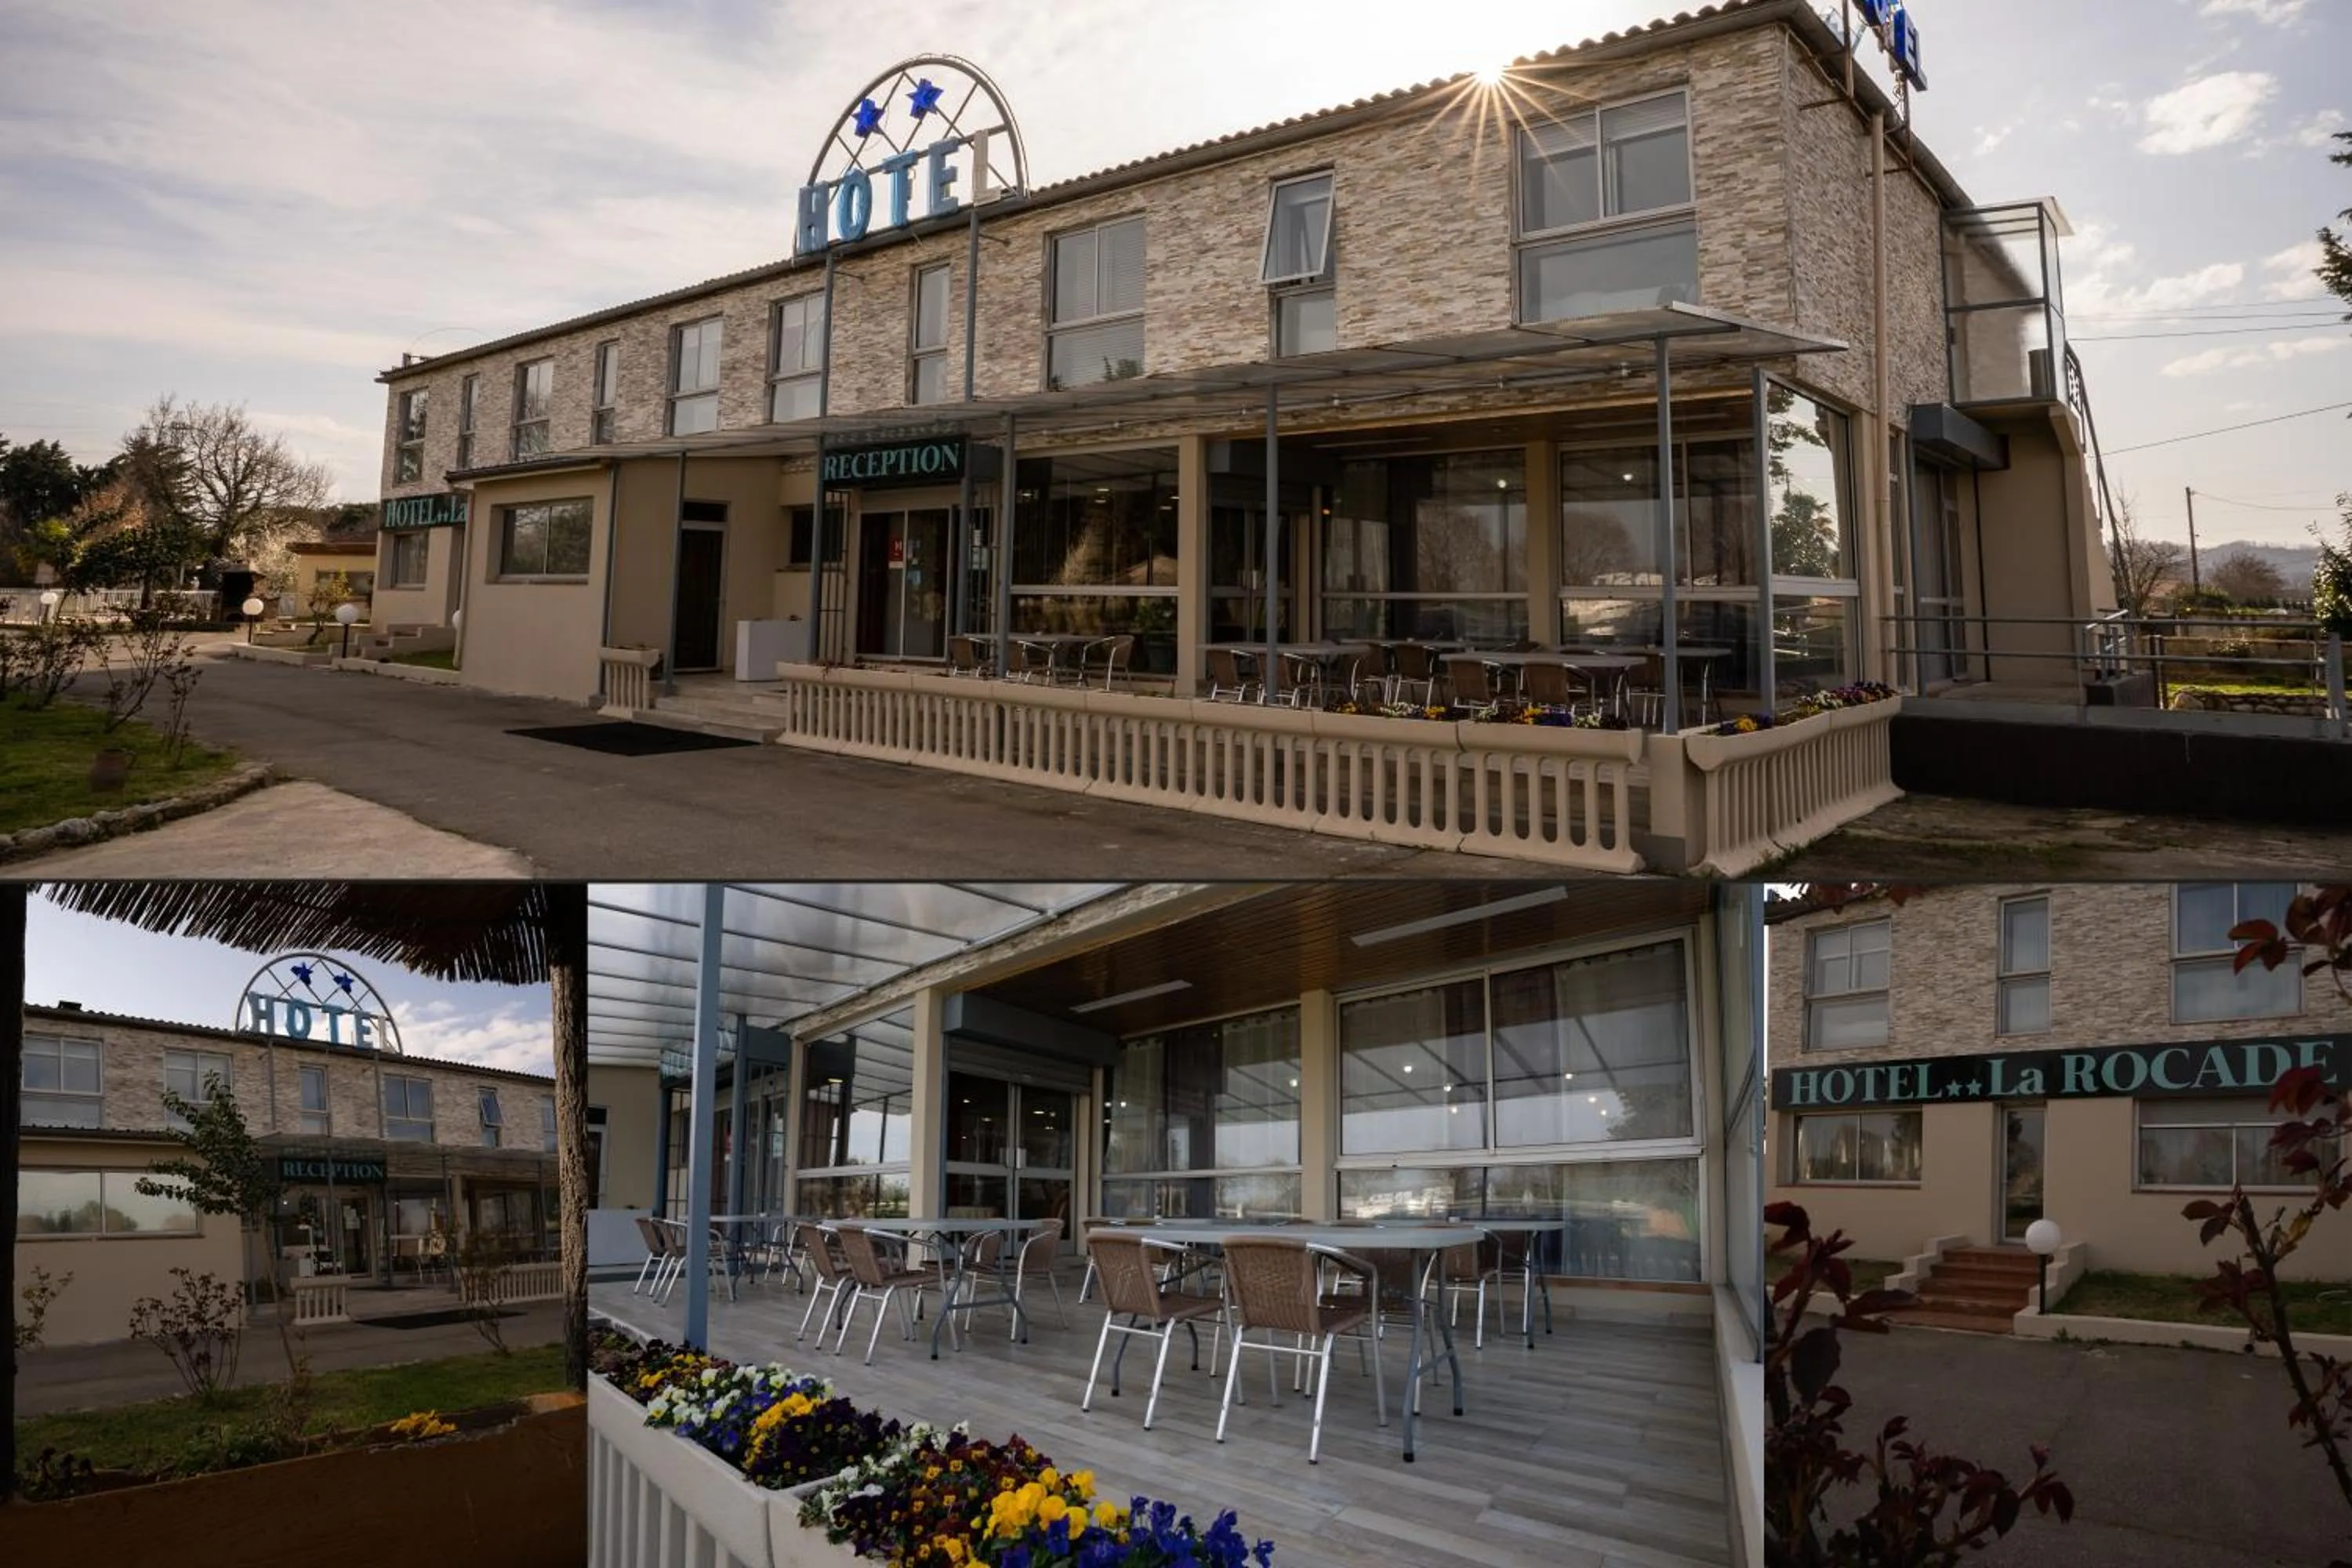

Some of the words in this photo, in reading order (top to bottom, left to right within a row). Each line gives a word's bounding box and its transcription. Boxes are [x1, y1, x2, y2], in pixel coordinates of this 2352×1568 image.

[797, 128, 1002, 255] HOTEL
[823, 442, 960, 481] RECEPTION
[385, 498, 437, 528] HOTEL
[247, 991, 397, 1054] HOTEL
[1788, 1062, 1943, 1105] HOTEL
[1987, 1058, 2045, 1096] La
[2059, 1040, 2338, 1094] ROCADE
